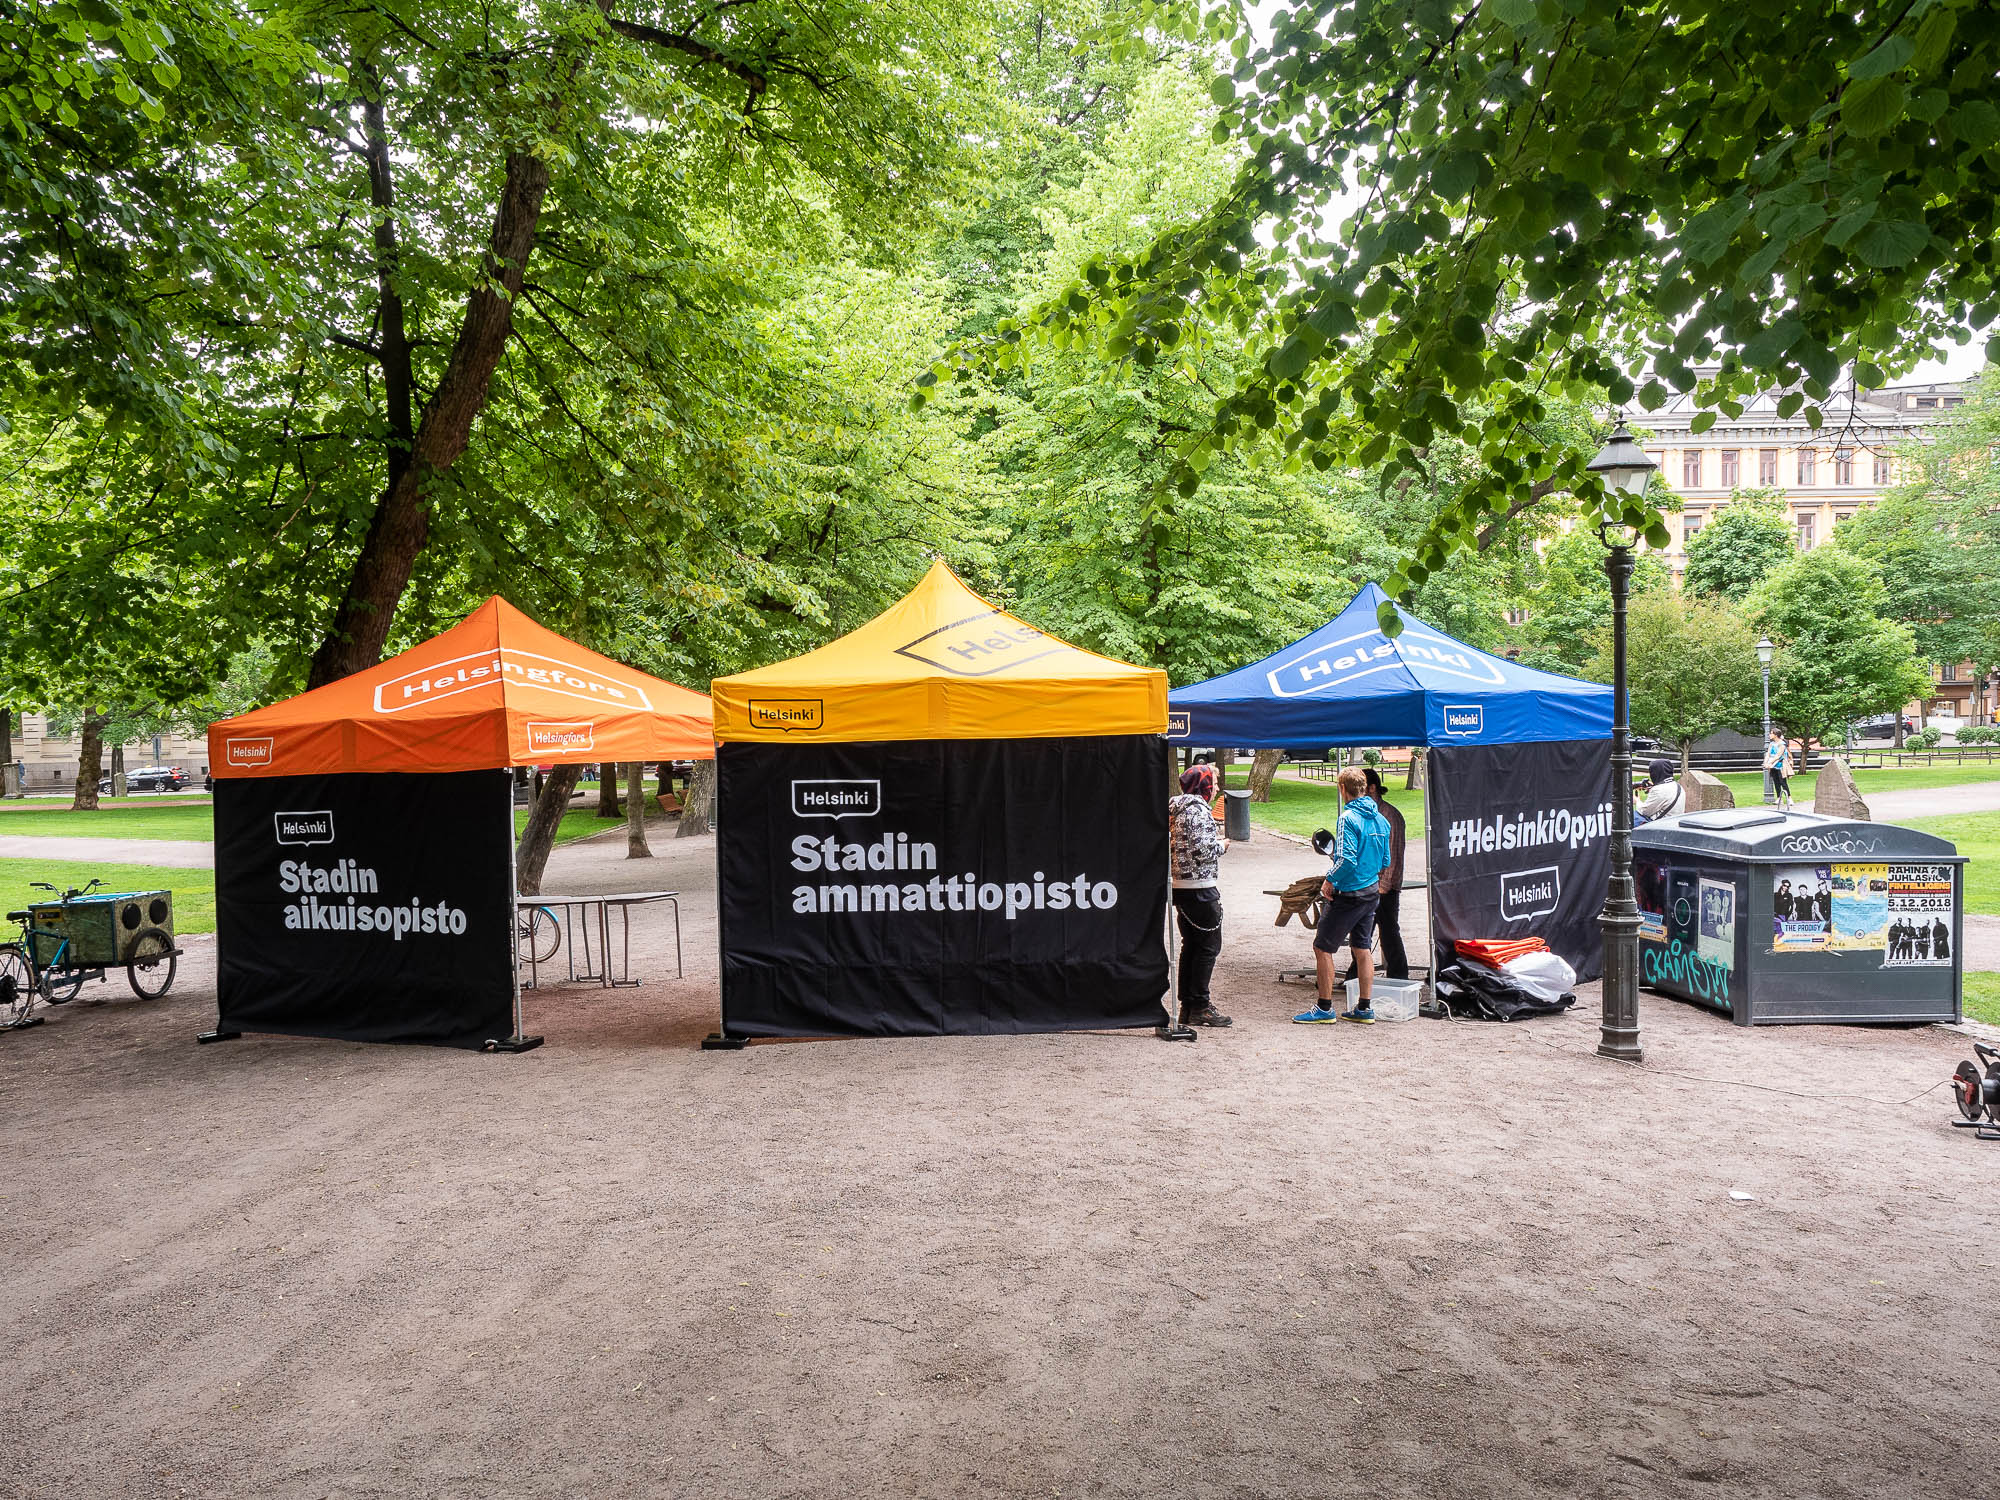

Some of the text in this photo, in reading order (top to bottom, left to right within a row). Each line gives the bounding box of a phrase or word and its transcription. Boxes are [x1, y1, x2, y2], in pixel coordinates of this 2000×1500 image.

[1300, 638, 1471, 681] Helsinki
[403, 659, 626, 698] Helsingfors
[759, 707, 814, 721] Helsinki
[1449, 713, 1479, 726] Helsinki
[535, 731, 586, 746] Helsingfors
[232, 745, 267, 759] Helsinki
[803, 791, 869, 805] Helsinki
[283, 821, 327, 836] Helsinki
[1449, 802, 1613, 858] #HelsinkiOppii
[790, 832, 937, 873] Stadin
[279, 858, 379, 894] Stadin
[1832, 865, 1886, 873] Sideways
[792, 871, 1118, 920] ammattiopisto
[1508, 882, 1552, 906] Helsinki
[1888, 898, 1951, 907] 5.12.2018
[284, 897, 467, 940] aikuisopisto
[1785, 924, 1822, 932] THE PRODIGY
